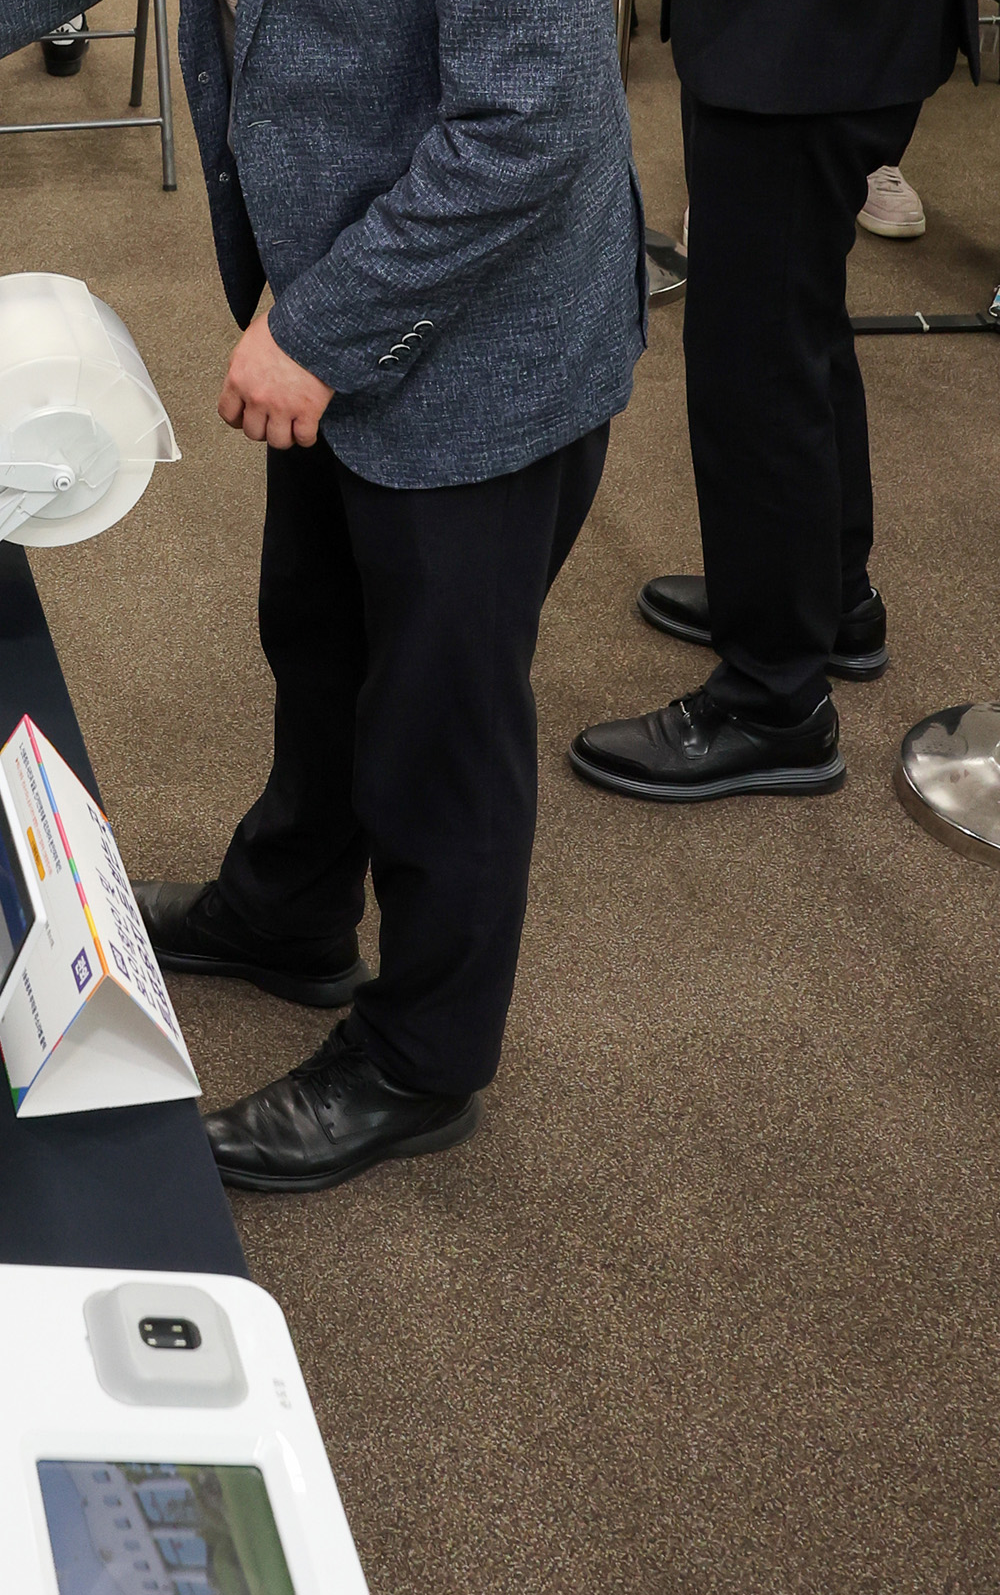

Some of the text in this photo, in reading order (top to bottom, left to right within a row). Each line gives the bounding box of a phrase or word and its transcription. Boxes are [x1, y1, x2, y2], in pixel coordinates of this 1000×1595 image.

[74, 955, 89, 987] 관외
[105, 895, 157, 1010] 본인확인
[125, 913, 180, 1040] 투표용지
